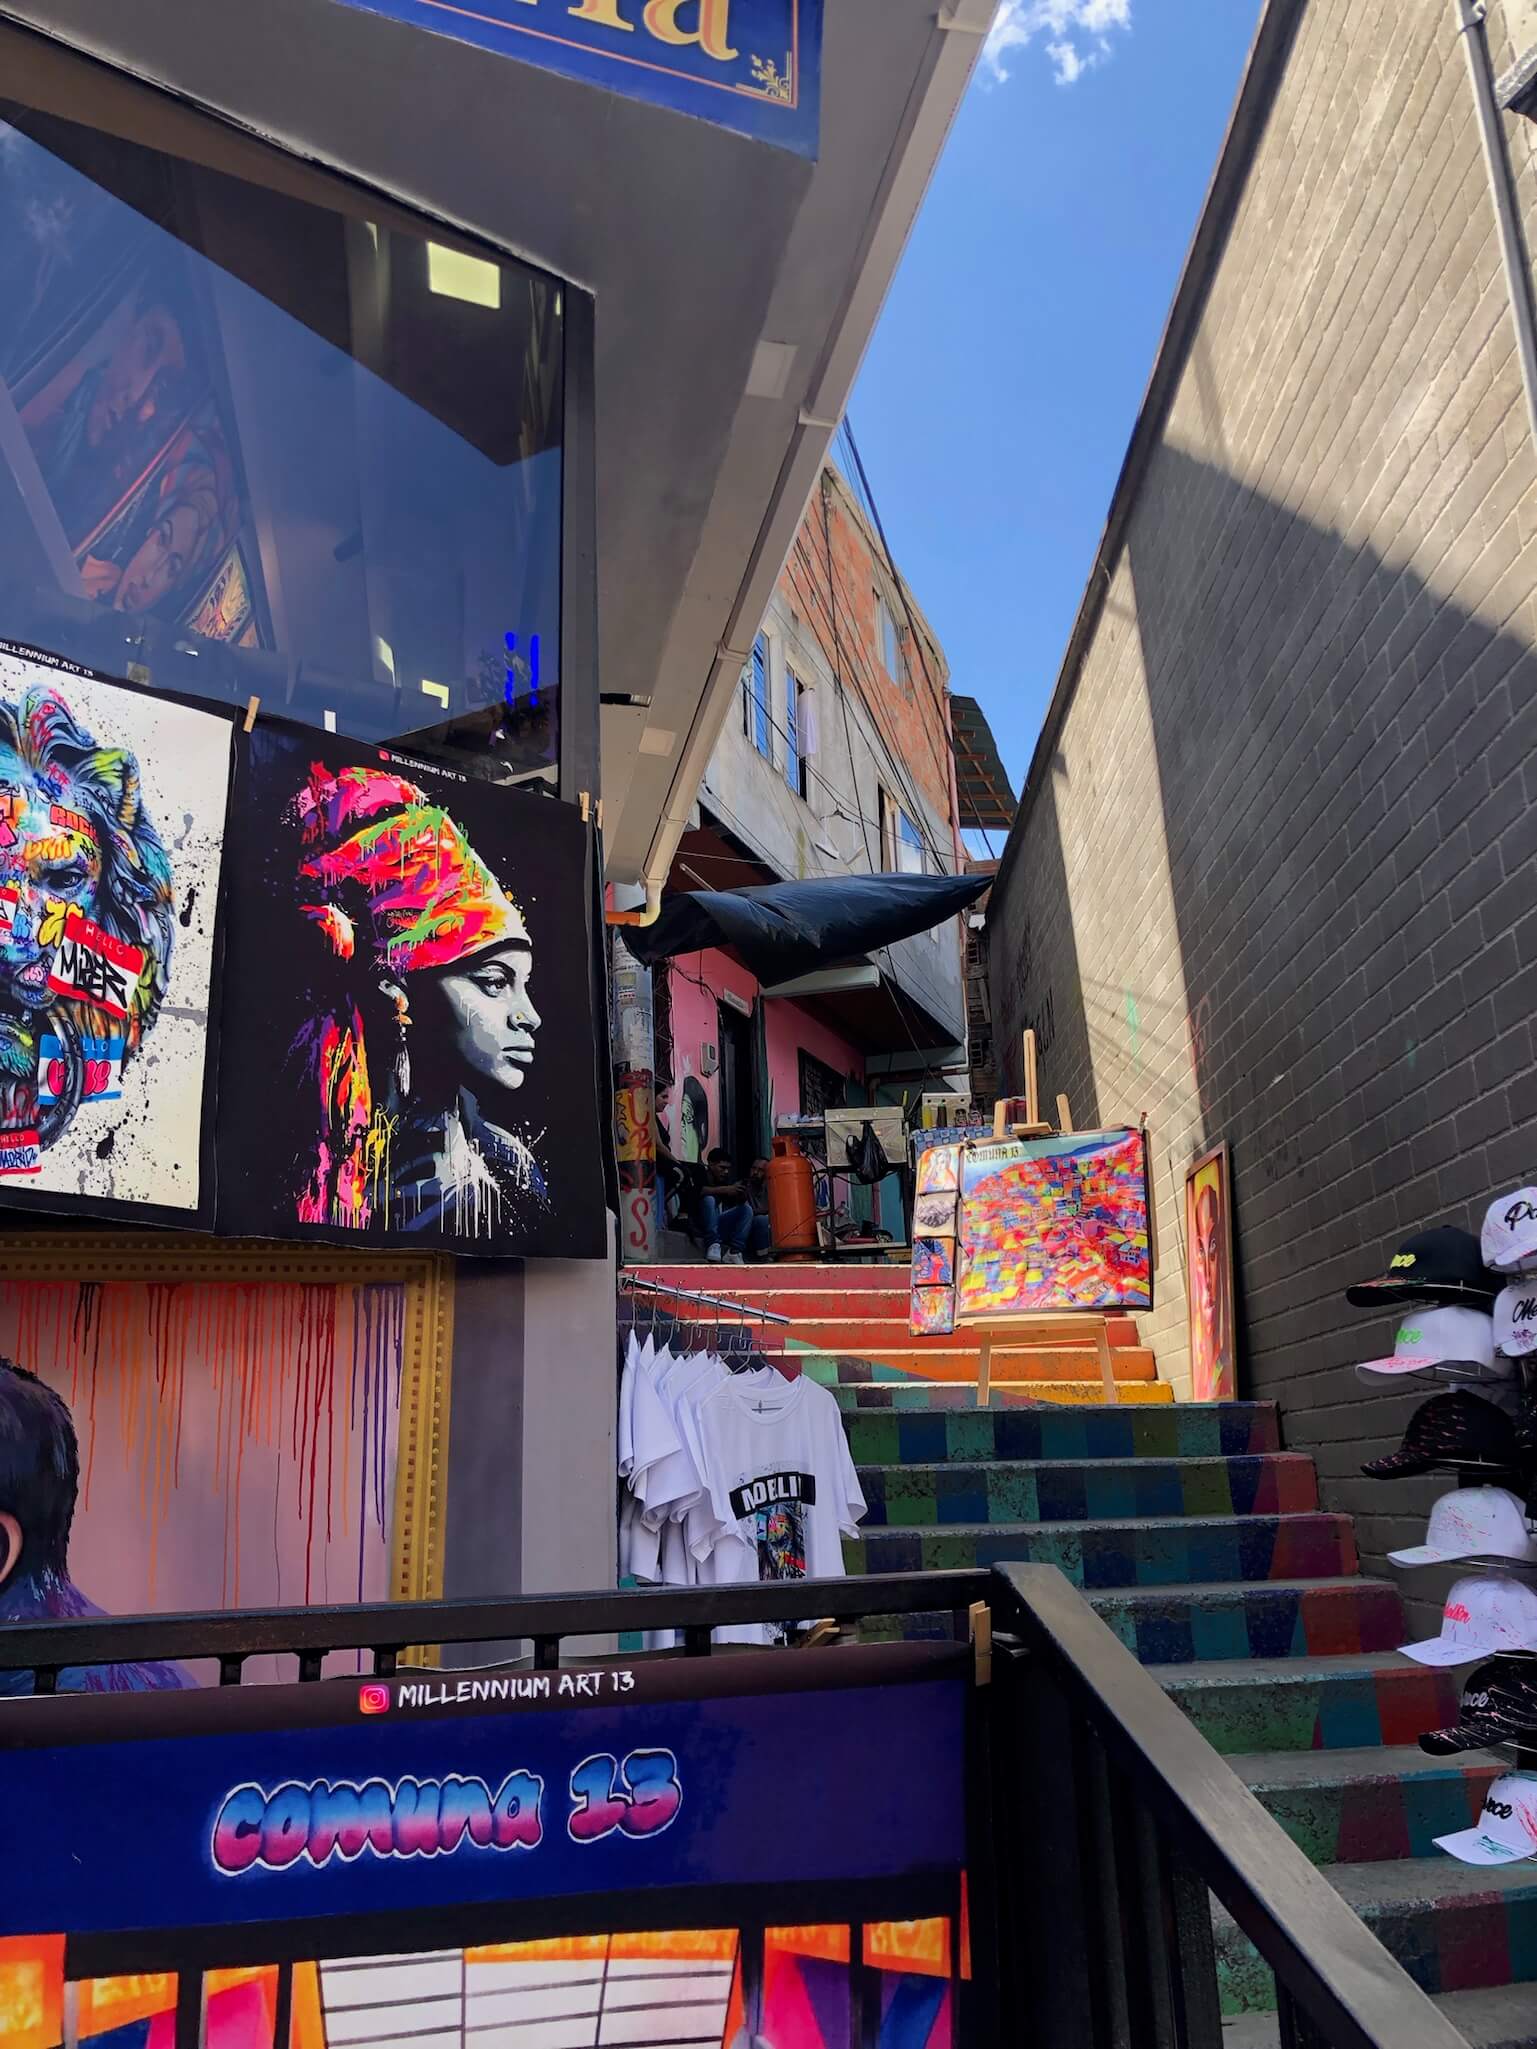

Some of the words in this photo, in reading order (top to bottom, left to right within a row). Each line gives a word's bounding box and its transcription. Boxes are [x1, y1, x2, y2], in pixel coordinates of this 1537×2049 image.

[61, 661, 81, 673] ART
[391, 754, 440, 776] MILLENNIUM
[441, 769, 457, 781] ART
[398, 1676, 550, 1708] MILLENNIUM
[558, 1672, 605, 1698] ART
[611, 1671, 635, 1692] 13
[567, 1748, 683, 1844] 13
